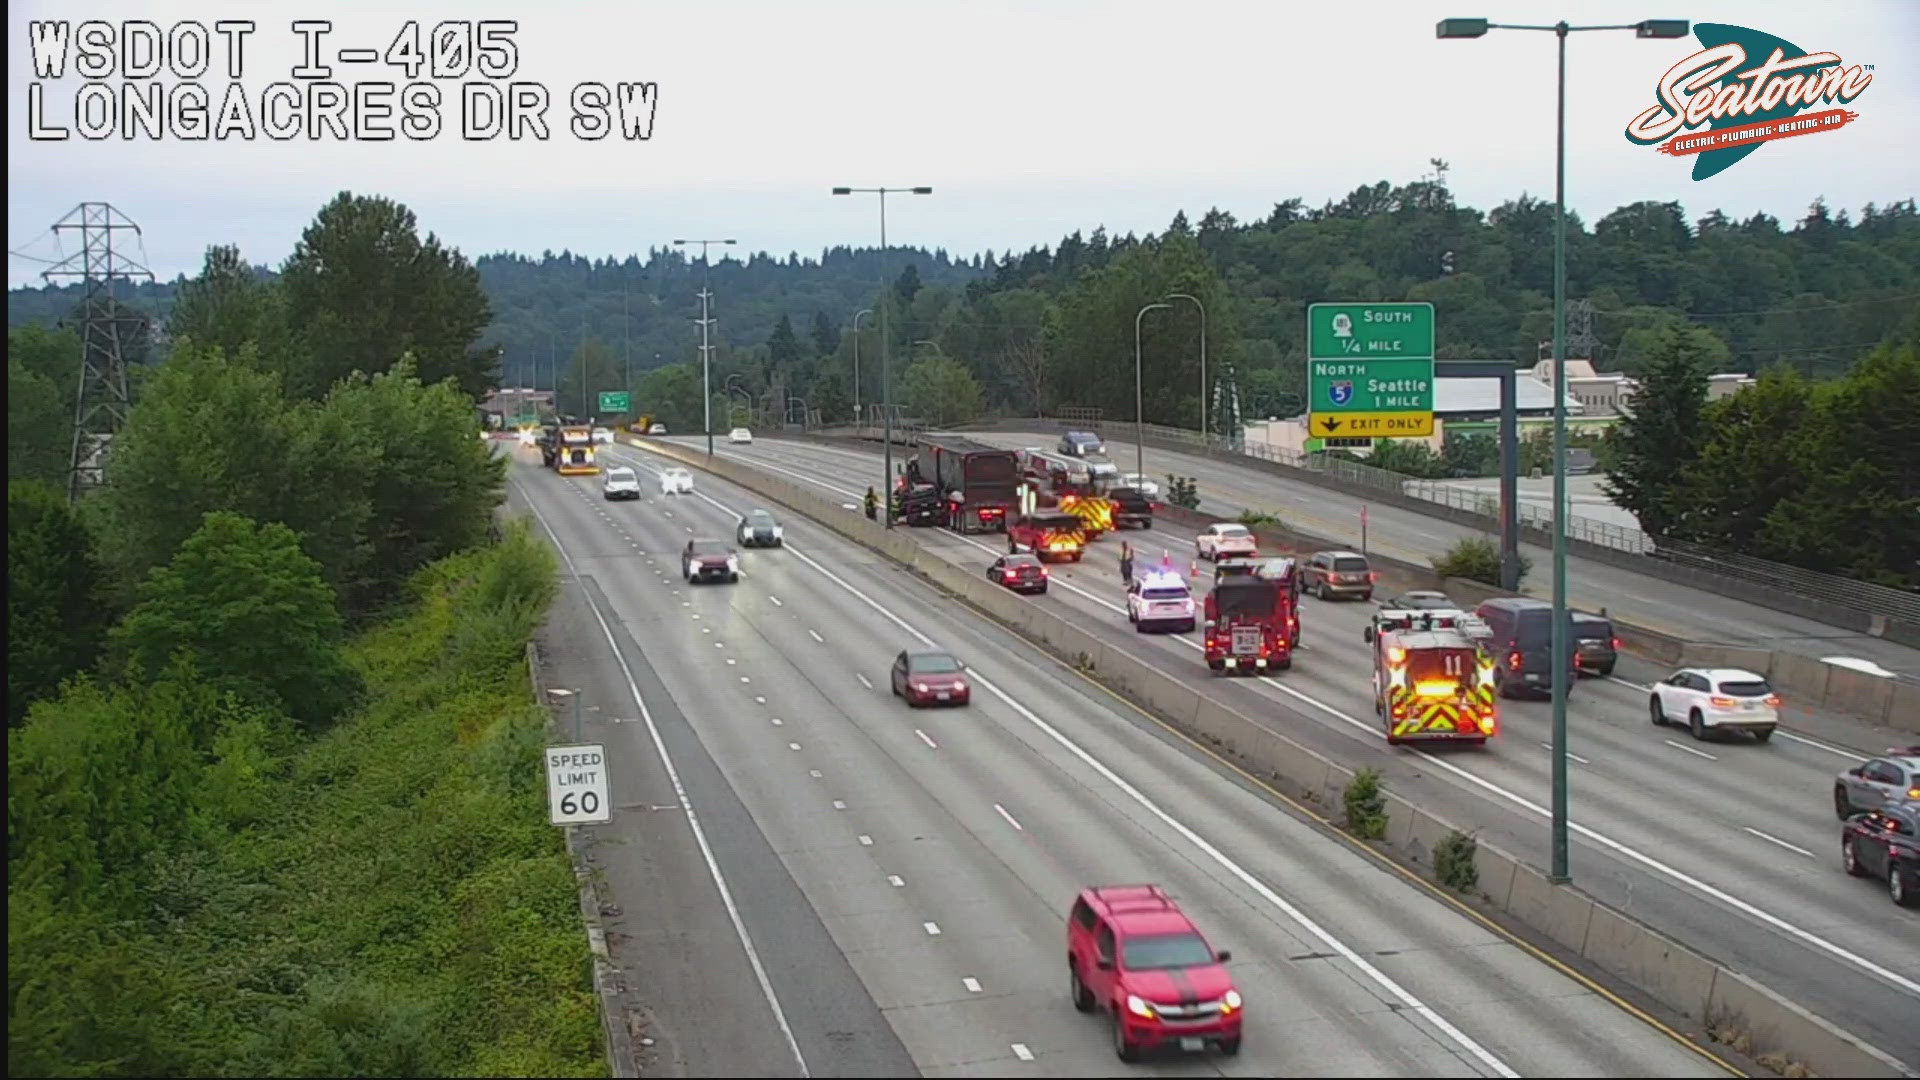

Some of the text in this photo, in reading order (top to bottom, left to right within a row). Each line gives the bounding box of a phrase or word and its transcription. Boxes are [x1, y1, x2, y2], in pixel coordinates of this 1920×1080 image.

[1368, 341, 1401, 351] MILE
[1367, 379, 1427, 392] Seattle
[1335, 387, 1346, 401] 5
[1375, 396, 1420, 408] 1 MILE
[1350, 418, 1423, 430] EXIT ONLY
[551, 753, 601, 767] SPEED
[558, 772, 597, 786] LIMIT
[560, 791, 599, 815] 60
